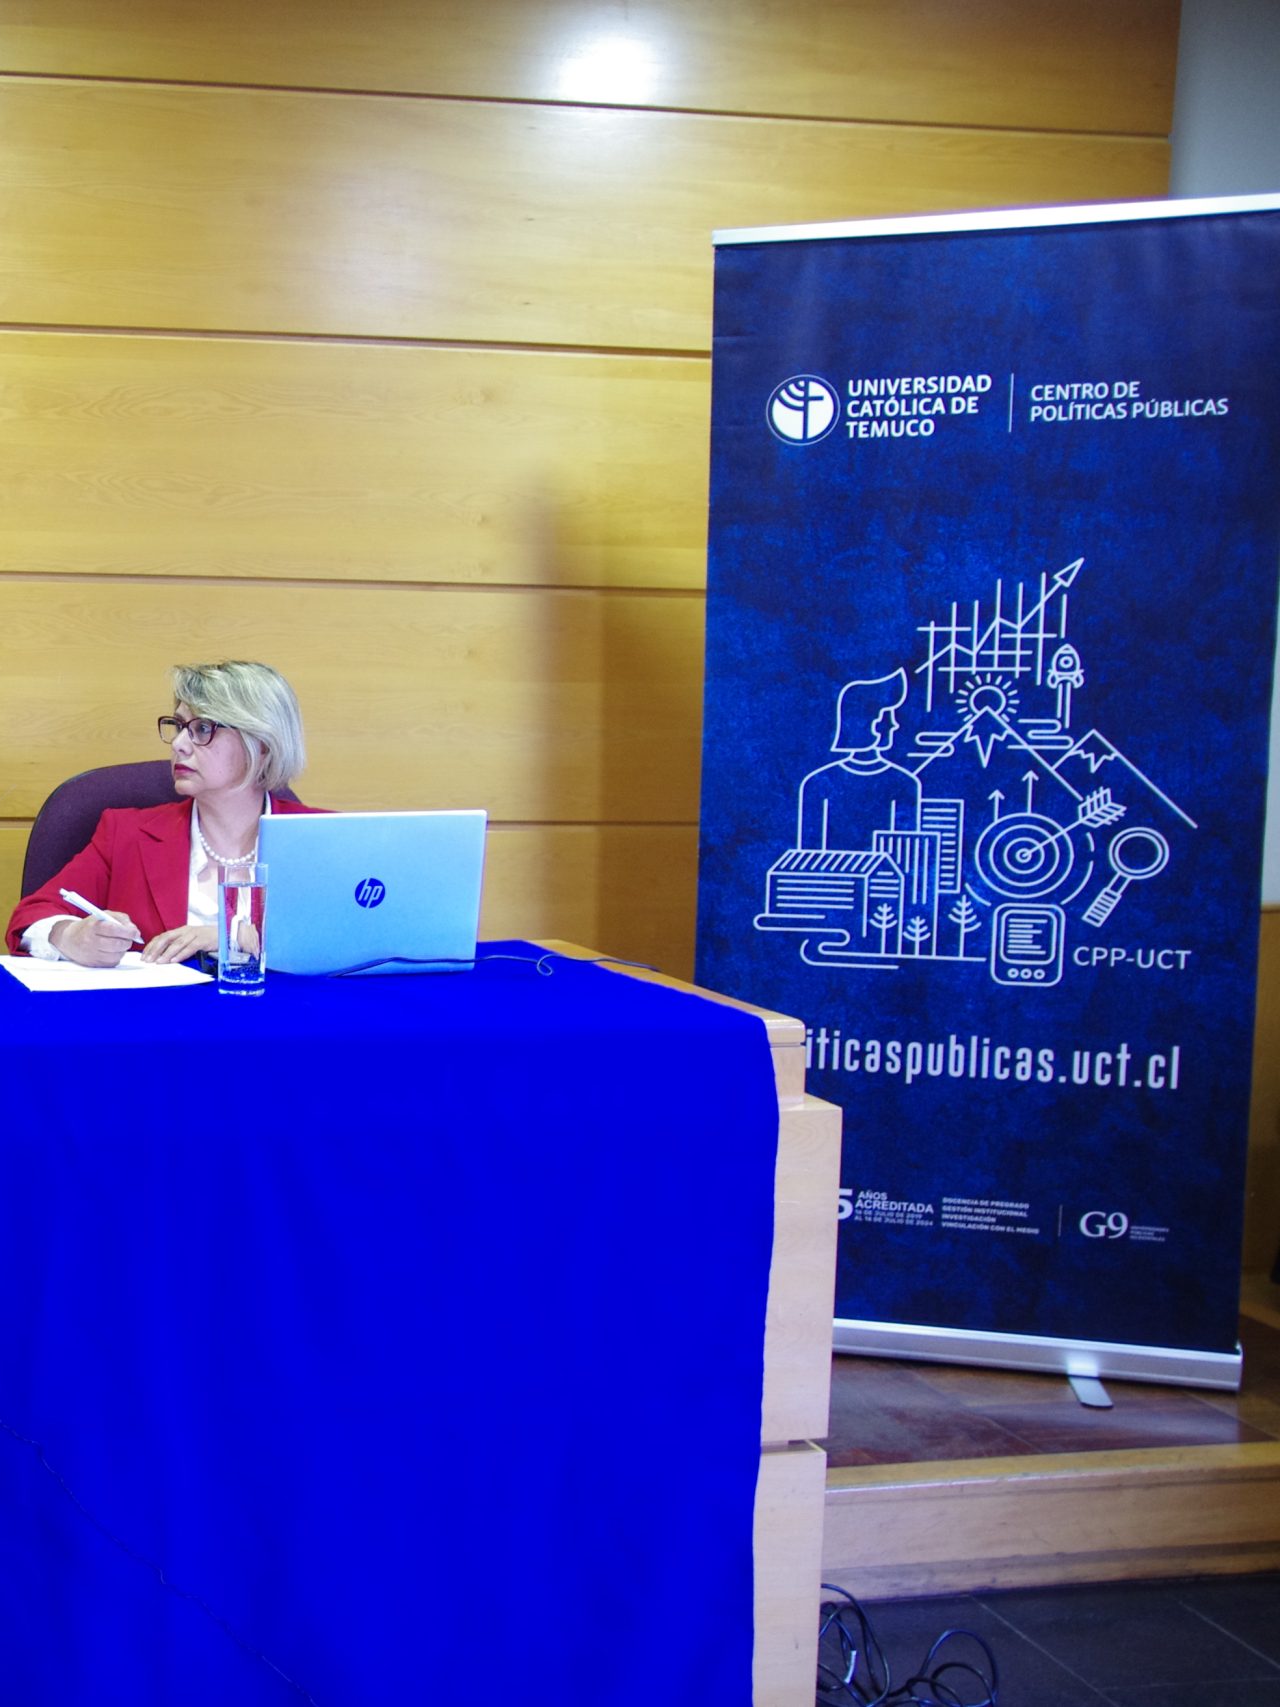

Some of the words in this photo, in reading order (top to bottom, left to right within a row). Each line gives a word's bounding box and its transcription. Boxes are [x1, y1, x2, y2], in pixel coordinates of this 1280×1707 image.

[848, 374, 992, 397] UNIVERSIDAD
[1030, 382, 1109, 402] CENTRO
[1113, 381, 1140, 398] DE
[847, 396, 946, 418] CATÓLICA
[951, 396, 979, 414] DE
[1030, 401, 1127, 422] POLÍTICAS
[1132, 398, 1229, 418] PÚBLICAS
[845, 419, 935, 438] TEMUCO
[358, 878, 383, 908] hp
[1073, 946, 1192, 970] CPP-UCT
[805, 1027, 1180, 1090] iticaspublicas.uct.cl
[855, 1199, 934, 1214] ACREDITADA
[858, 1190, 887, 1200] AÑOS
[1079, 1211, 1128, 1239] G9
